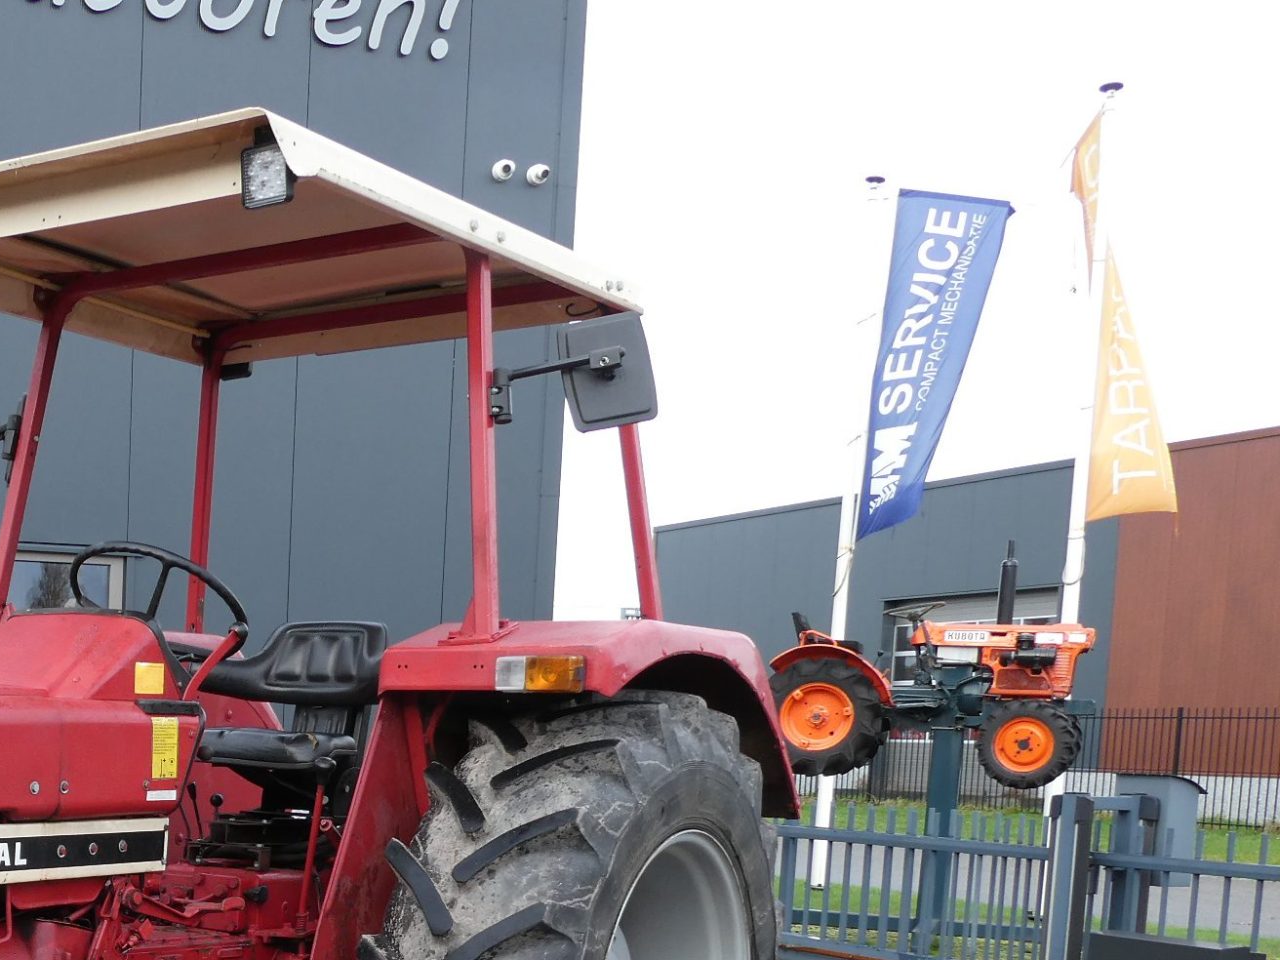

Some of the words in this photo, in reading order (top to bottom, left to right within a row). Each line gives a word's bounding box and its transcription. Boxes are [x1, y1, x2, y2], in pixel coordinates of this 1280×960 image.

[879, 207, 968, 415] SERVICE
[915, 328, 949, 411] COMPACT
[947, 632, 985, 641] KUBOTA
